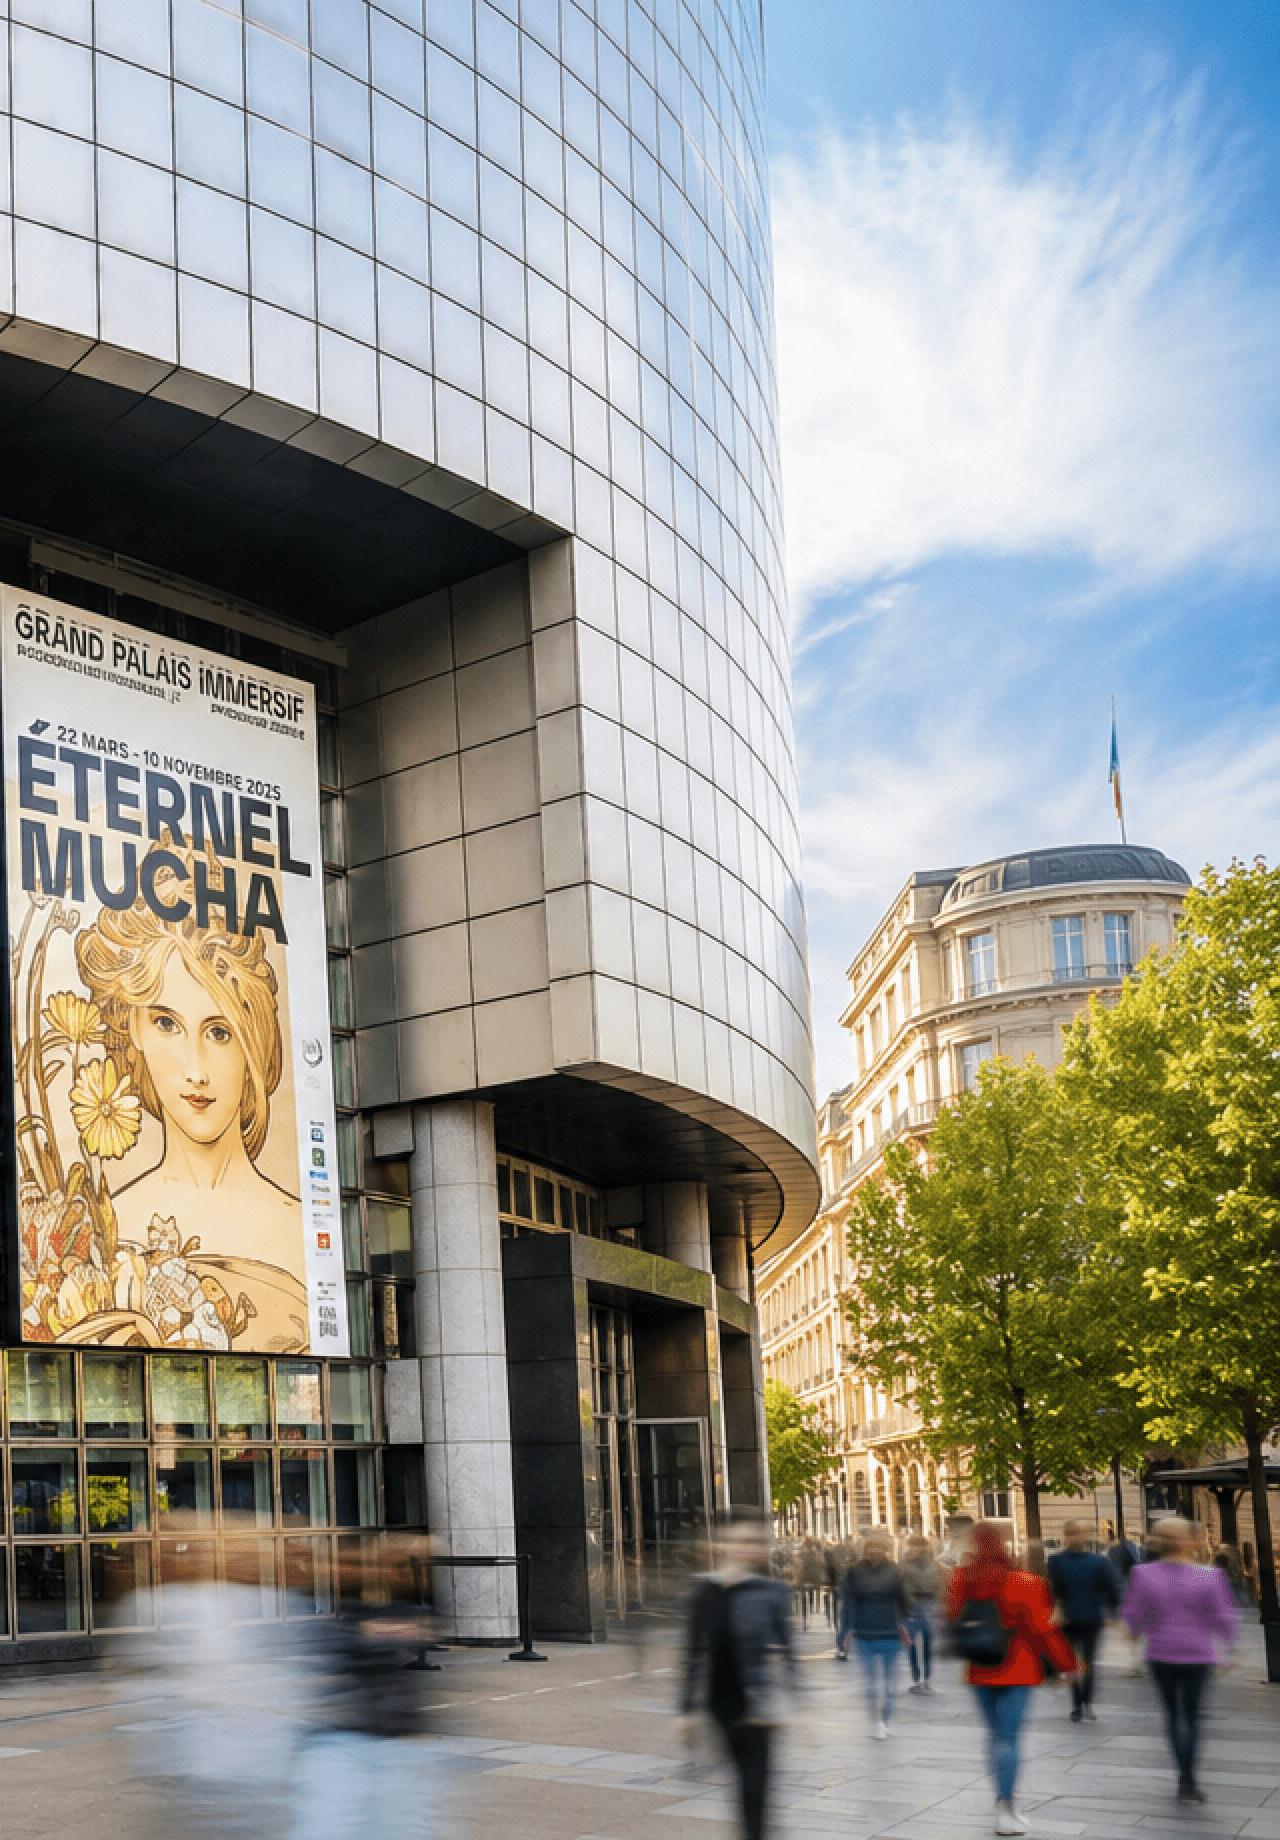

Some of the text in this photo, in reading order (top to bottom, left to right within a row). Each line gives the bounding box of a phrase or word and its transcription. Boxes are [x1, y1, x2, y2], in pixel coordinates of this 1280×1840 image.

[15, 604, 104, 662] GRAND
[111, 632, 192, 690] PALAIS
[198, 660, 305, 723] IMMERSIF
[17, 718, 312, 879] ÉTERNEL
[57, 725, 78, 745] 22
[82, 733, 129, 759] MARS
[143, 749, 160, 767] 10
[163, 755, 243, 790] NOVEMBRE
[245, 779, 282, 800] 2025
[20, 818, 289, 945] MUCHA
